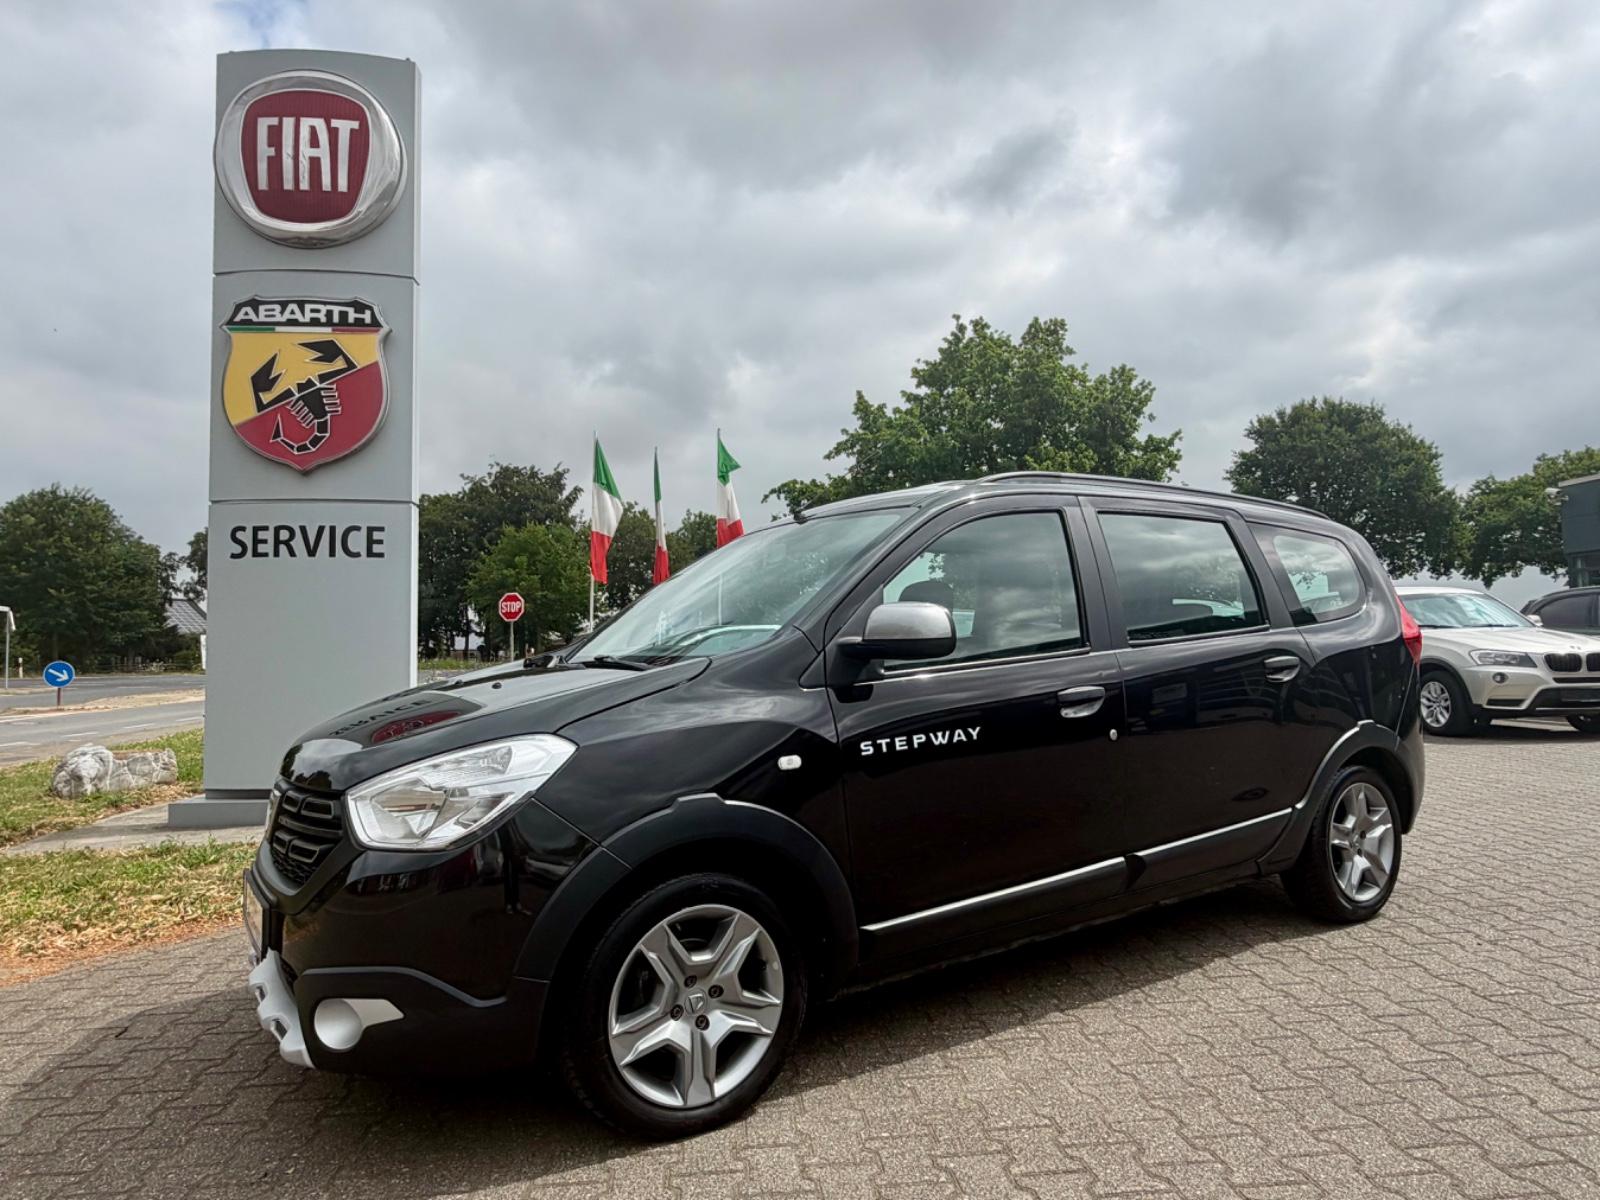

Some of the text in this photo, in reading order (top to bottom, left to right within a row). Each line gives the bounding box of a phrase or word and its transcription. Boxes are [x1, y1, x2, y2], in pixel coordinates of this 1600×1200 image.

[256, 116, 360, 193] FIAT
[233, 303, 372, 325] ABARTH
[229, 524, 387, 560] SERVICE
[501, 601, 522, 613] STOP
[859, 726, 981, 756] STEPWAY
